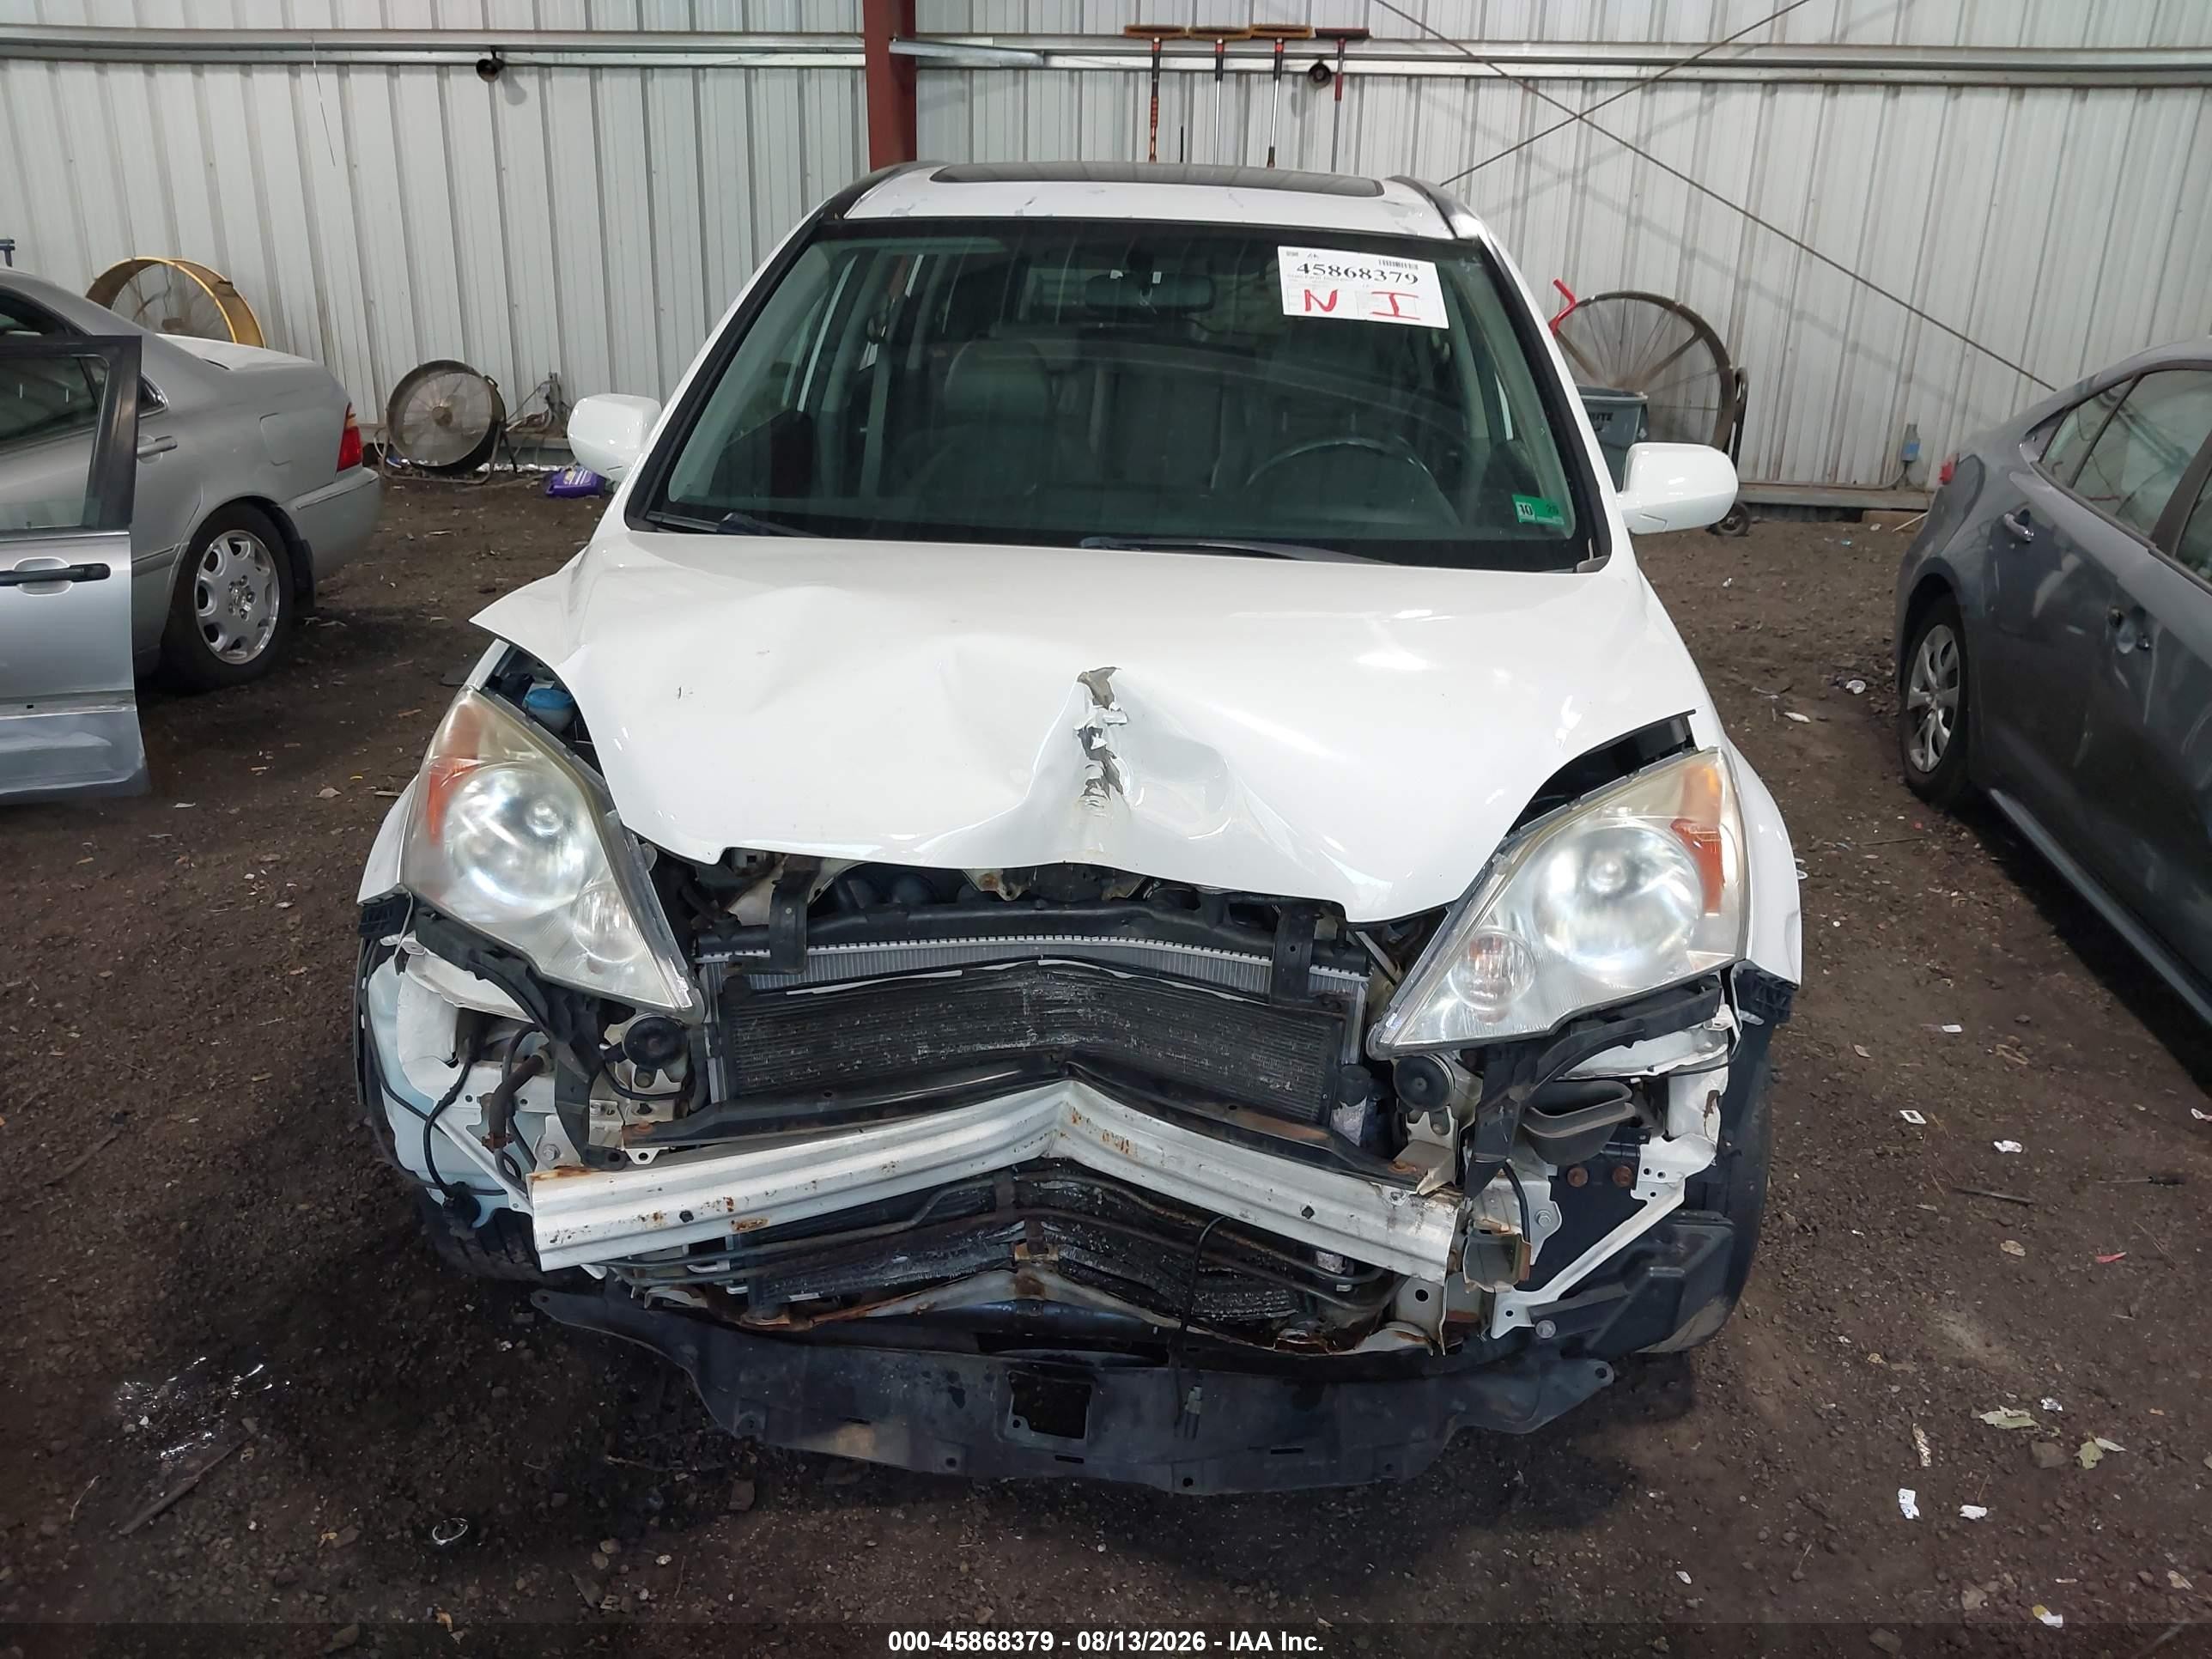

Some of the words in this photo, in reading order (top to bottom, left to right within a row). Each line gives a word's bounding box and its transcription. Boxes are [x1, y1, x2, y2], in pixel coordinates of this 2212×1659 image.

[1297, 262, 1419, 285] 45868379
[1304, 289, 1339, 313] N
[1519, 504, 1534, 516] 10
